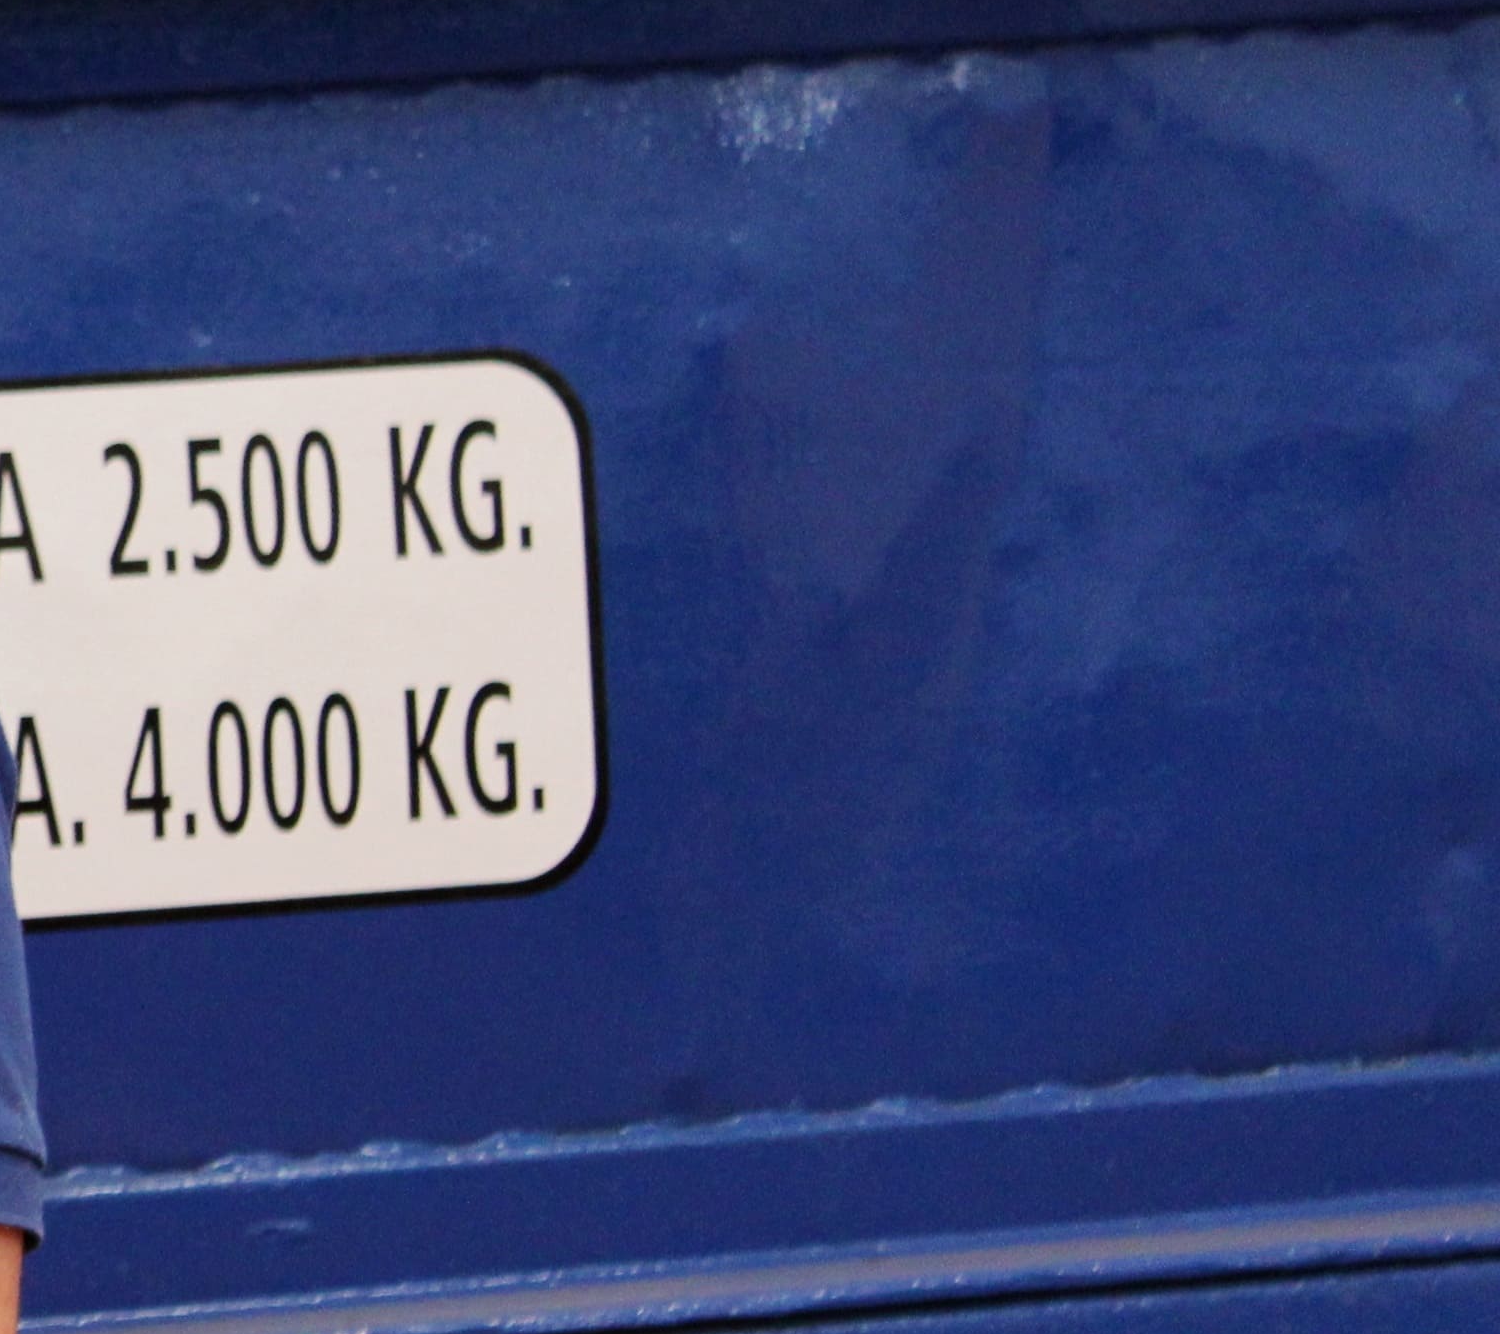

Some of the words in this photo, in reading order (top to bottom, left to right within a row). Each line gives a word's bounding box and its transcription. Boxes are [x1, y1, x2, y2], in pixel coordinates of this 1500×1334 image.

[103, 429, 341, 576] 2.500
[388, 420, 533, 557] KG.
[125, 692, 360, 841] 4.000
[404, 680, 545, 822] KG.
